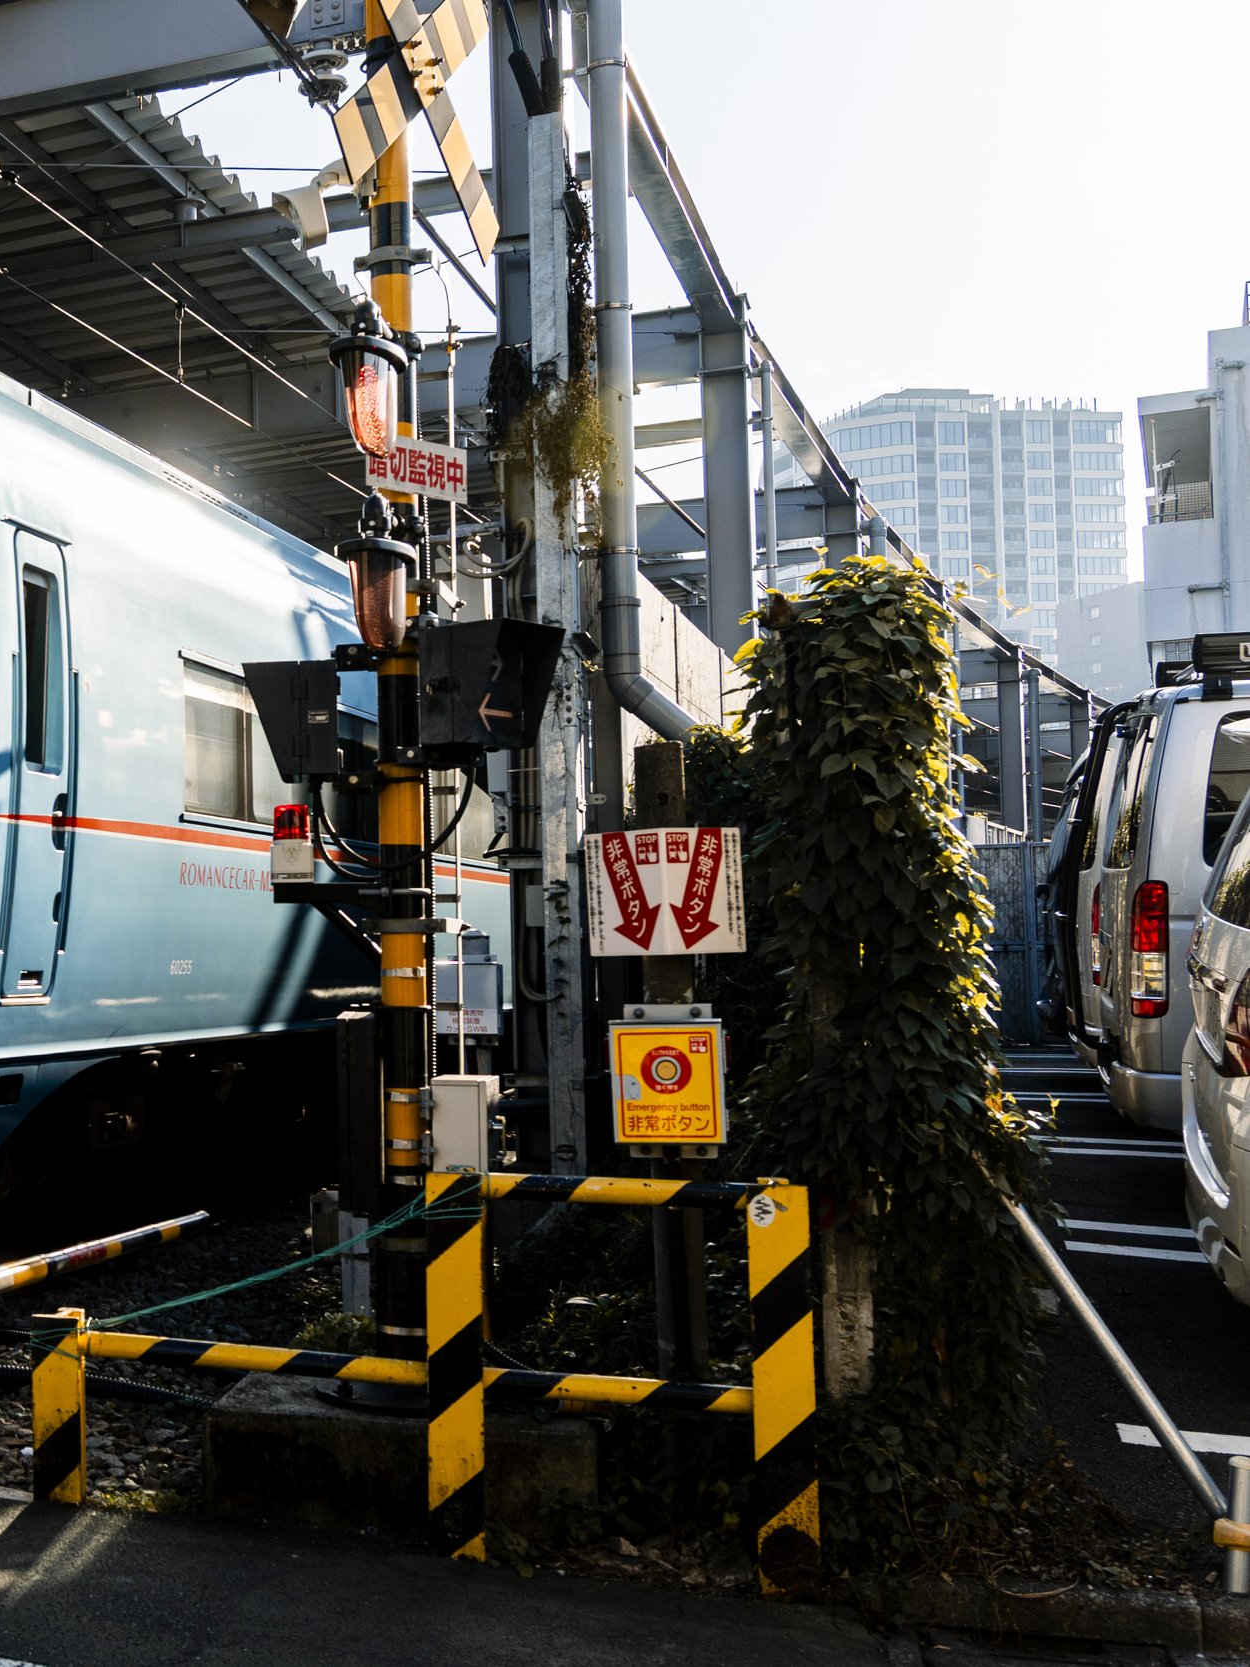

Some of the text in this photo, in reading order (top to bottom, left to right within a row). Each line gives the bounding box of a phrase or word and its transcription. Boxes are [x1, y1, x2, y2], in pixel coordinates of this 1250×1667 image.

[636, 834, 658, 844] STOP
[667, 833, 688, 844] STOP
[606, 839, 647, 939] 非常ボタン
[684, 834, 719, 933] 非常ボタン
[170, 960, 192, 975] 60255
[627, 1102, 710, 1113] Emergency button
[628, 1115, 710, 1132] 非常ボタン
